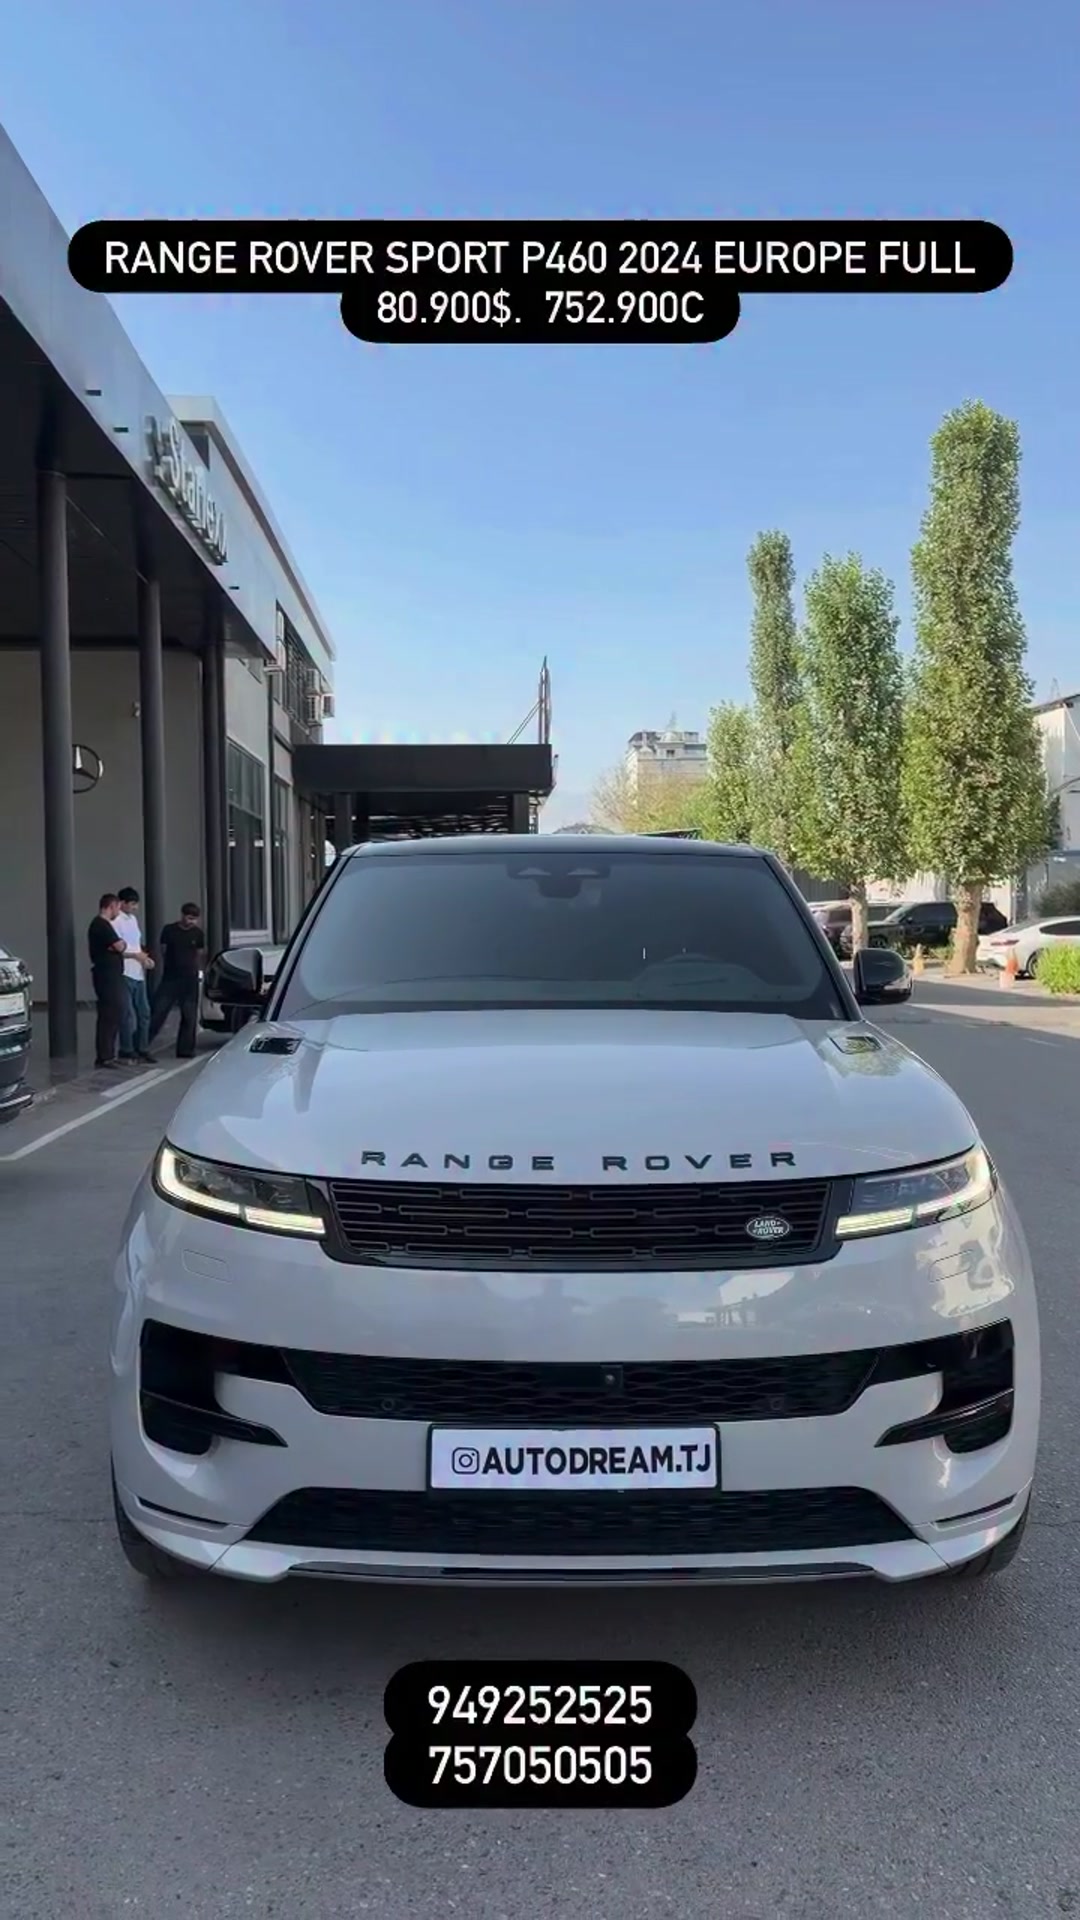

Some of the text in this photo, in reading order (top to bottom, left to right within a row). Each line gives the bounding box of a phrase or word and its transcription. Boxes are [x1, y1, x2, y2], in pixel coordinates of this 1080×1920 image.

[361, 1150, 797, 1172] RANGE ROVER
[482, 1443, 711, 1476] AUTODREAM.TJ
